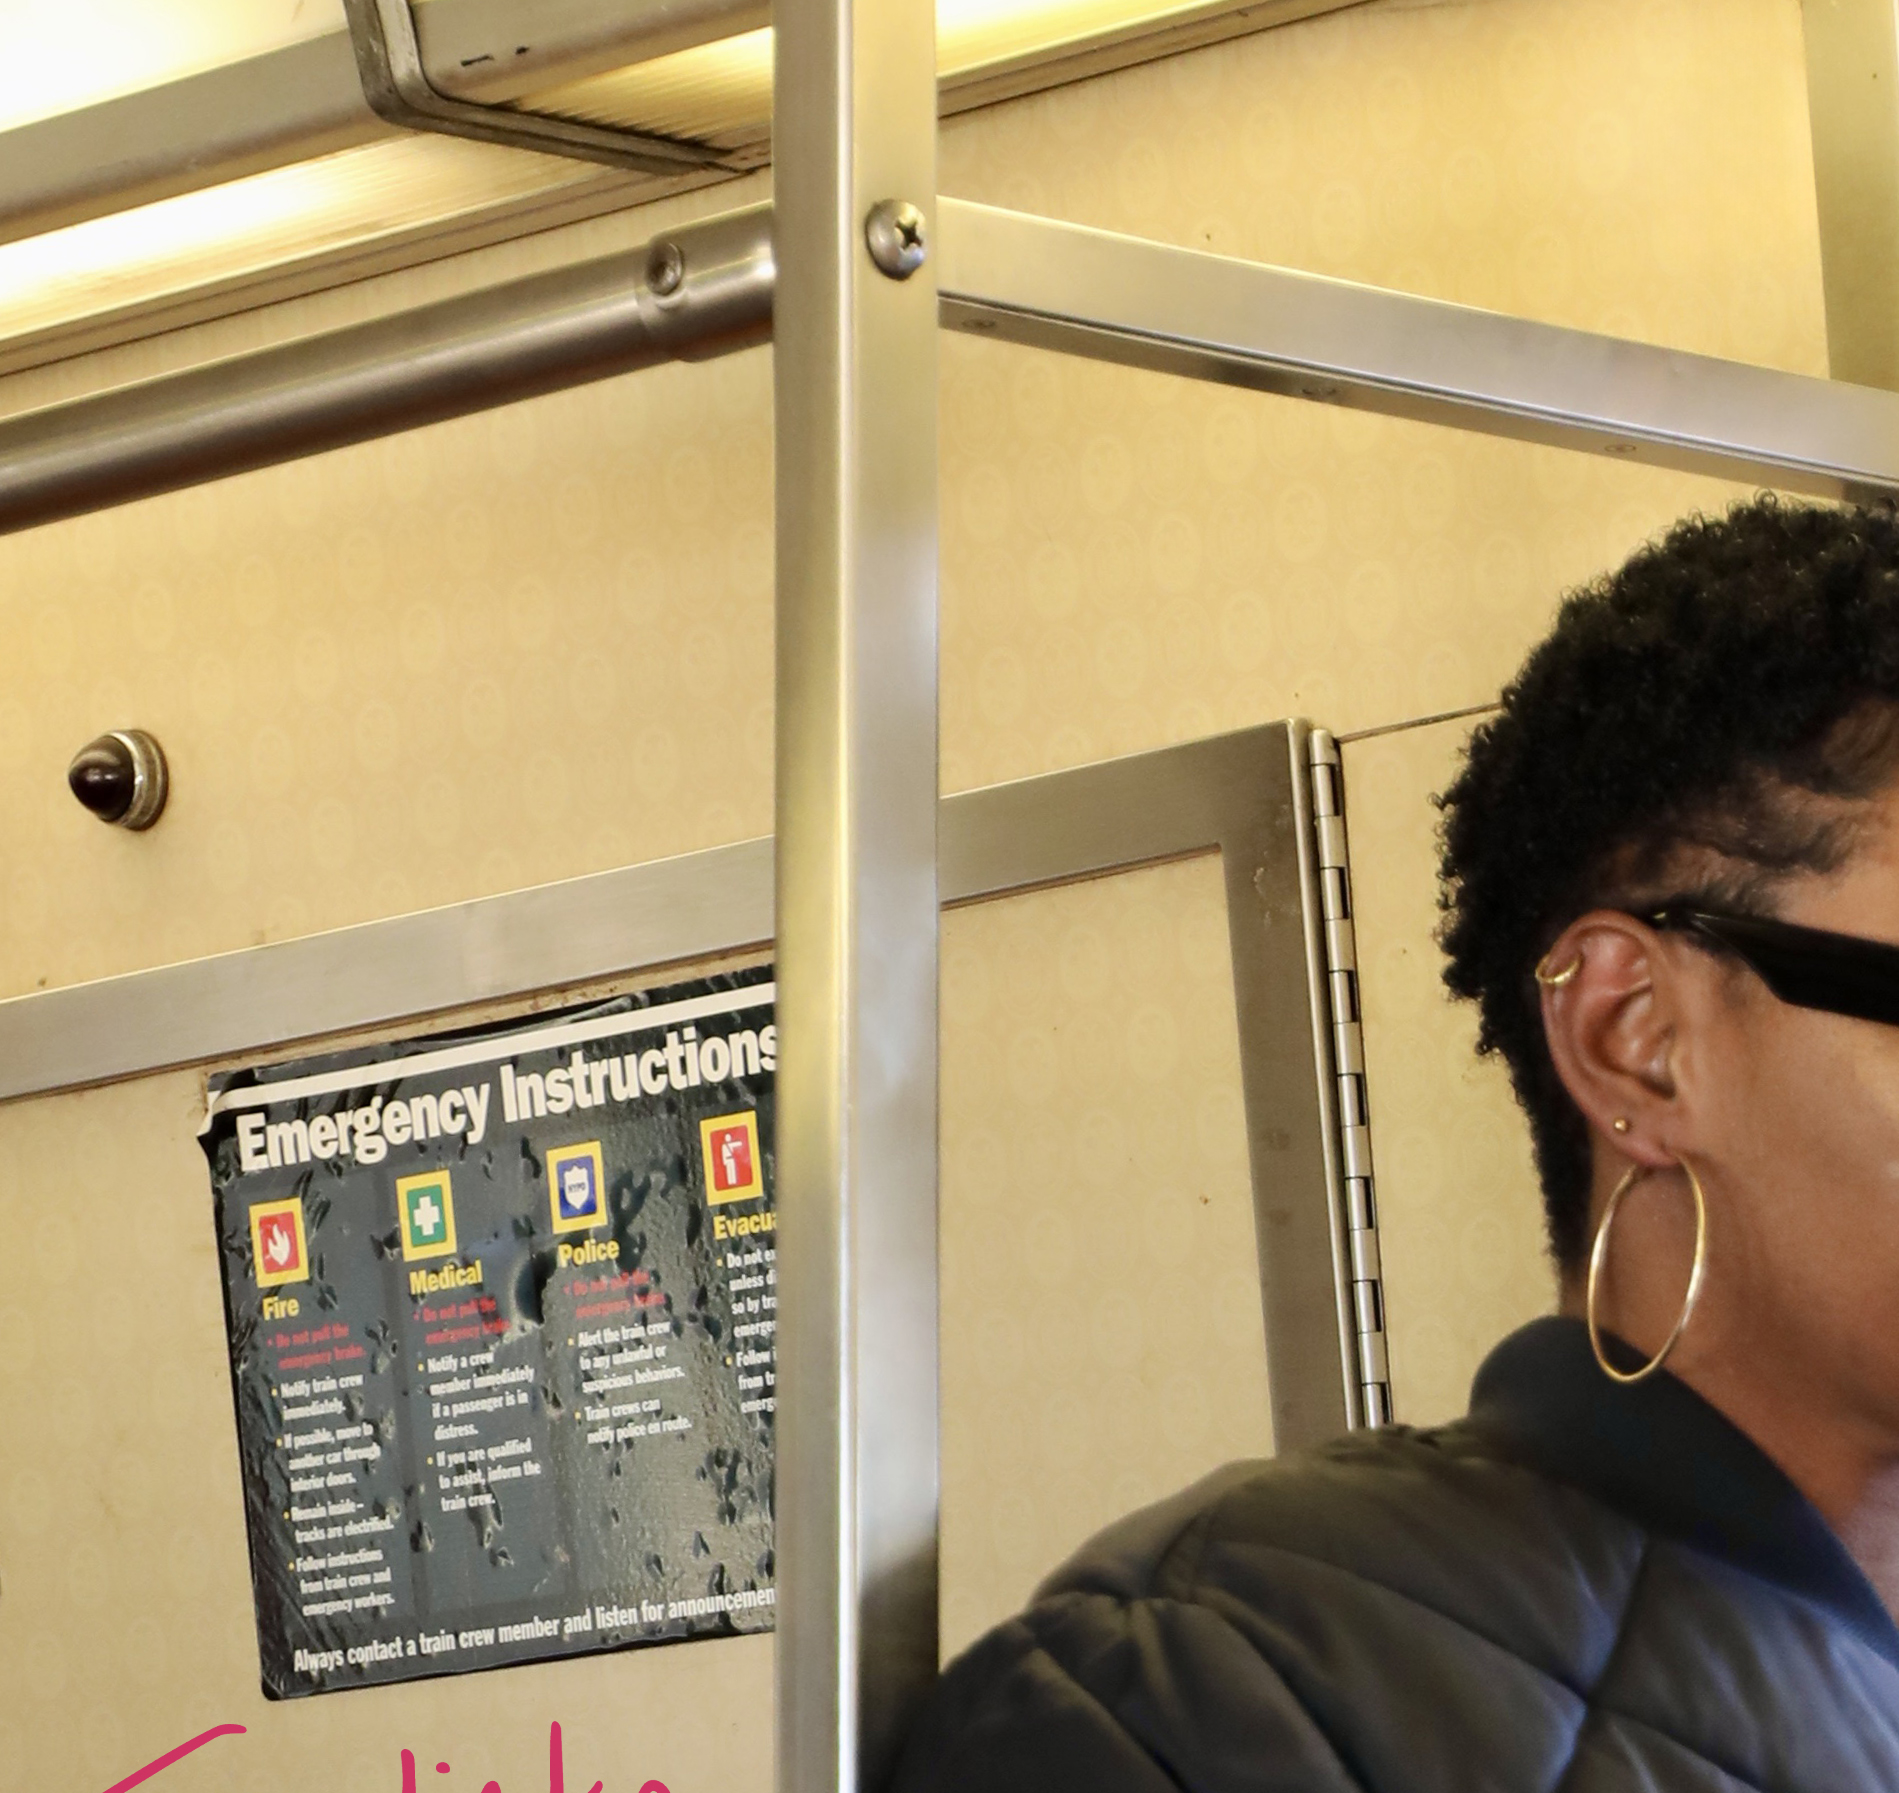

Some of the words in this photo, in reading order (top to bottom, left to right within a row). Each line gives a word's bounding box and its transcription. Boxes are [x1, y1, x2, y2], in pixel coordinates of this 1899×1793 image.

[236, 1082, 491, 1172] Emergency
[500, 1025, 776, 1123] Instructions
[557, 1238, 620, 1268] Police
[727, 1252, 742, 1268] Do
[743, 1248, 763, 1266] not
[409, 1259, 483, 1295] Medical
[729, 1273, 764, 1292] unless
[262, 1296, 300, 1321] Fire
[731, 1302, 745, 1315] so
[746, 1297, 760, 1314] by
[603, 1327, 620, 1344] the
[621, 1322, 646, 1340] train
[647, 1321, 671, 1336] crew
[427, 1354, 458, 1373] Notify
[460, 1357, 467, 1368] a
[469, 1352, 494, 1366] crew
[580, 1356, 592, 1371] to
[592, 1354, 611, 1369] any
[612, 1343, 654, 1365] unlawful
[654, 1345, 667, 1358] or
[736, 1349, 771, 1367] Follow
[280, 1380, 311, 1398] Notify
[312, 1375, 337, 1393] train
[339, 1374, 364, 1389] crew
[430, 1377, 471, 1396] member
[472, 1364, 535, 1389] immediately
[582, 1373, 634, 1393] suspicious
[634, 1364, 686, 1384] behaviors.
[738, 1375, 764, 1390] from
[432, 1402, 441, 1418] if
[442, 1405, 450, 1417] a
[452, 1395, 504, 1418] passenger
[504, 1390, 516, 1406] is
[517, 1389, 529, 1405] in
[584, 1403, 610, 1421] Train
[611, 1402, 641, 1417] crews
[642, 1399, 661, 1412] can
[741, 1398, 777, 1413] emerg
[335, 1425, 361, 1440] move
[362, 1421, 374, 1436] to
[434, 1423, 479, 1441] distress.
[587, 1426, 615, 1444] notify
[616, 1421, 647, 1442] police
[647, 1422, 661, 1434] en
[662, 1415, 693, 1432] route.
[326, 1451, 342, 1464] car
[343, 1441, 382, 1462] through
[436, 1451, 446, 1467] If
[447, 1452, 466, 1468] you
[467, 1448, 485, 1461] are
[487, 1437, 532, 1461] qualified
[326, 1471, 357, 1487] doors.
[438, 1474, 450, 1489] to
[452, 1469, 486, 1488] assist,
[487, 1464, 522, 1482] inform
[523, 1460, 541, 1476] the
[290, 1502, 327, 1522] Remain
[441, 1495, 466, 1512] train
[468, 1493, 496, 1507] crew.
[294, 1525, 326, 1544] tracks
[326, 1526, 343, 1539] are
[327, 1548, 384, 1569] instructions
[300, 1578, 324, 1595] from
[324, 1573, 348, 1591] train
[348, 1573, 372, 1588] crew
[373, 1566, 392, 1583] and
[302, 1599, 353, 1617] emergency
[354, 1591, 396, 1609] workers.
[294, 1649, 345, 1673] Always
[347, 1637, 404, 1665] contact
[406, 1639, 417, 1656] a
[419, 1629, 456, 1655] train
[458, 1627, 495, 1649] crew
[498, 1616, 560, 1643] member
[563, 1606, 592, 1634] and
[595, 1605, 638, 1629] listen
[640, 1600, 665, 1623] for
[668, 1587, 776, 1619] announcemen
